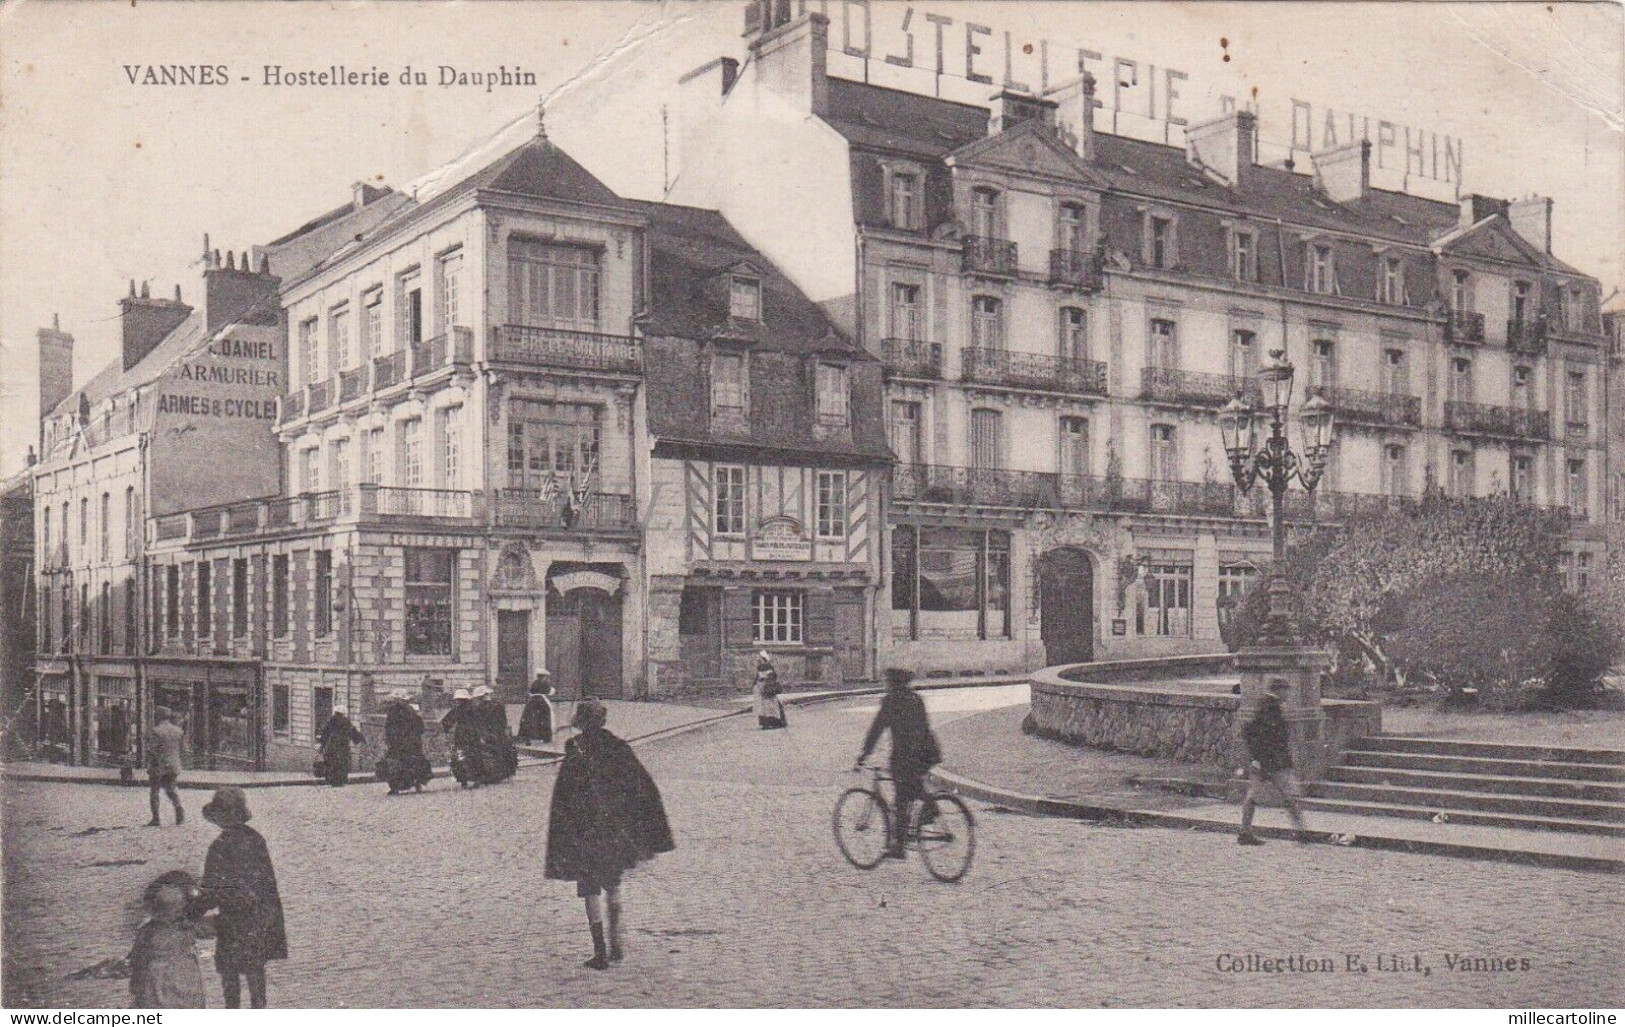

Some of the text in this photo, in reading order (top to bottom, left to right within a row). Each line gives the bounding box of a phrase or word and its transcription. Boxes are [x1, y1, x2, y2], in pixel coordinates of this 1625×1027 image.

[800, 0, 1189, 126] OSTELLERIE
[222, 339, 277, 360] DANIEL
[180, 363, 280, 387] ARMURIER
[159, 394, 210, 416] ARMES
[224, 398, 278, 420] CYCLE
